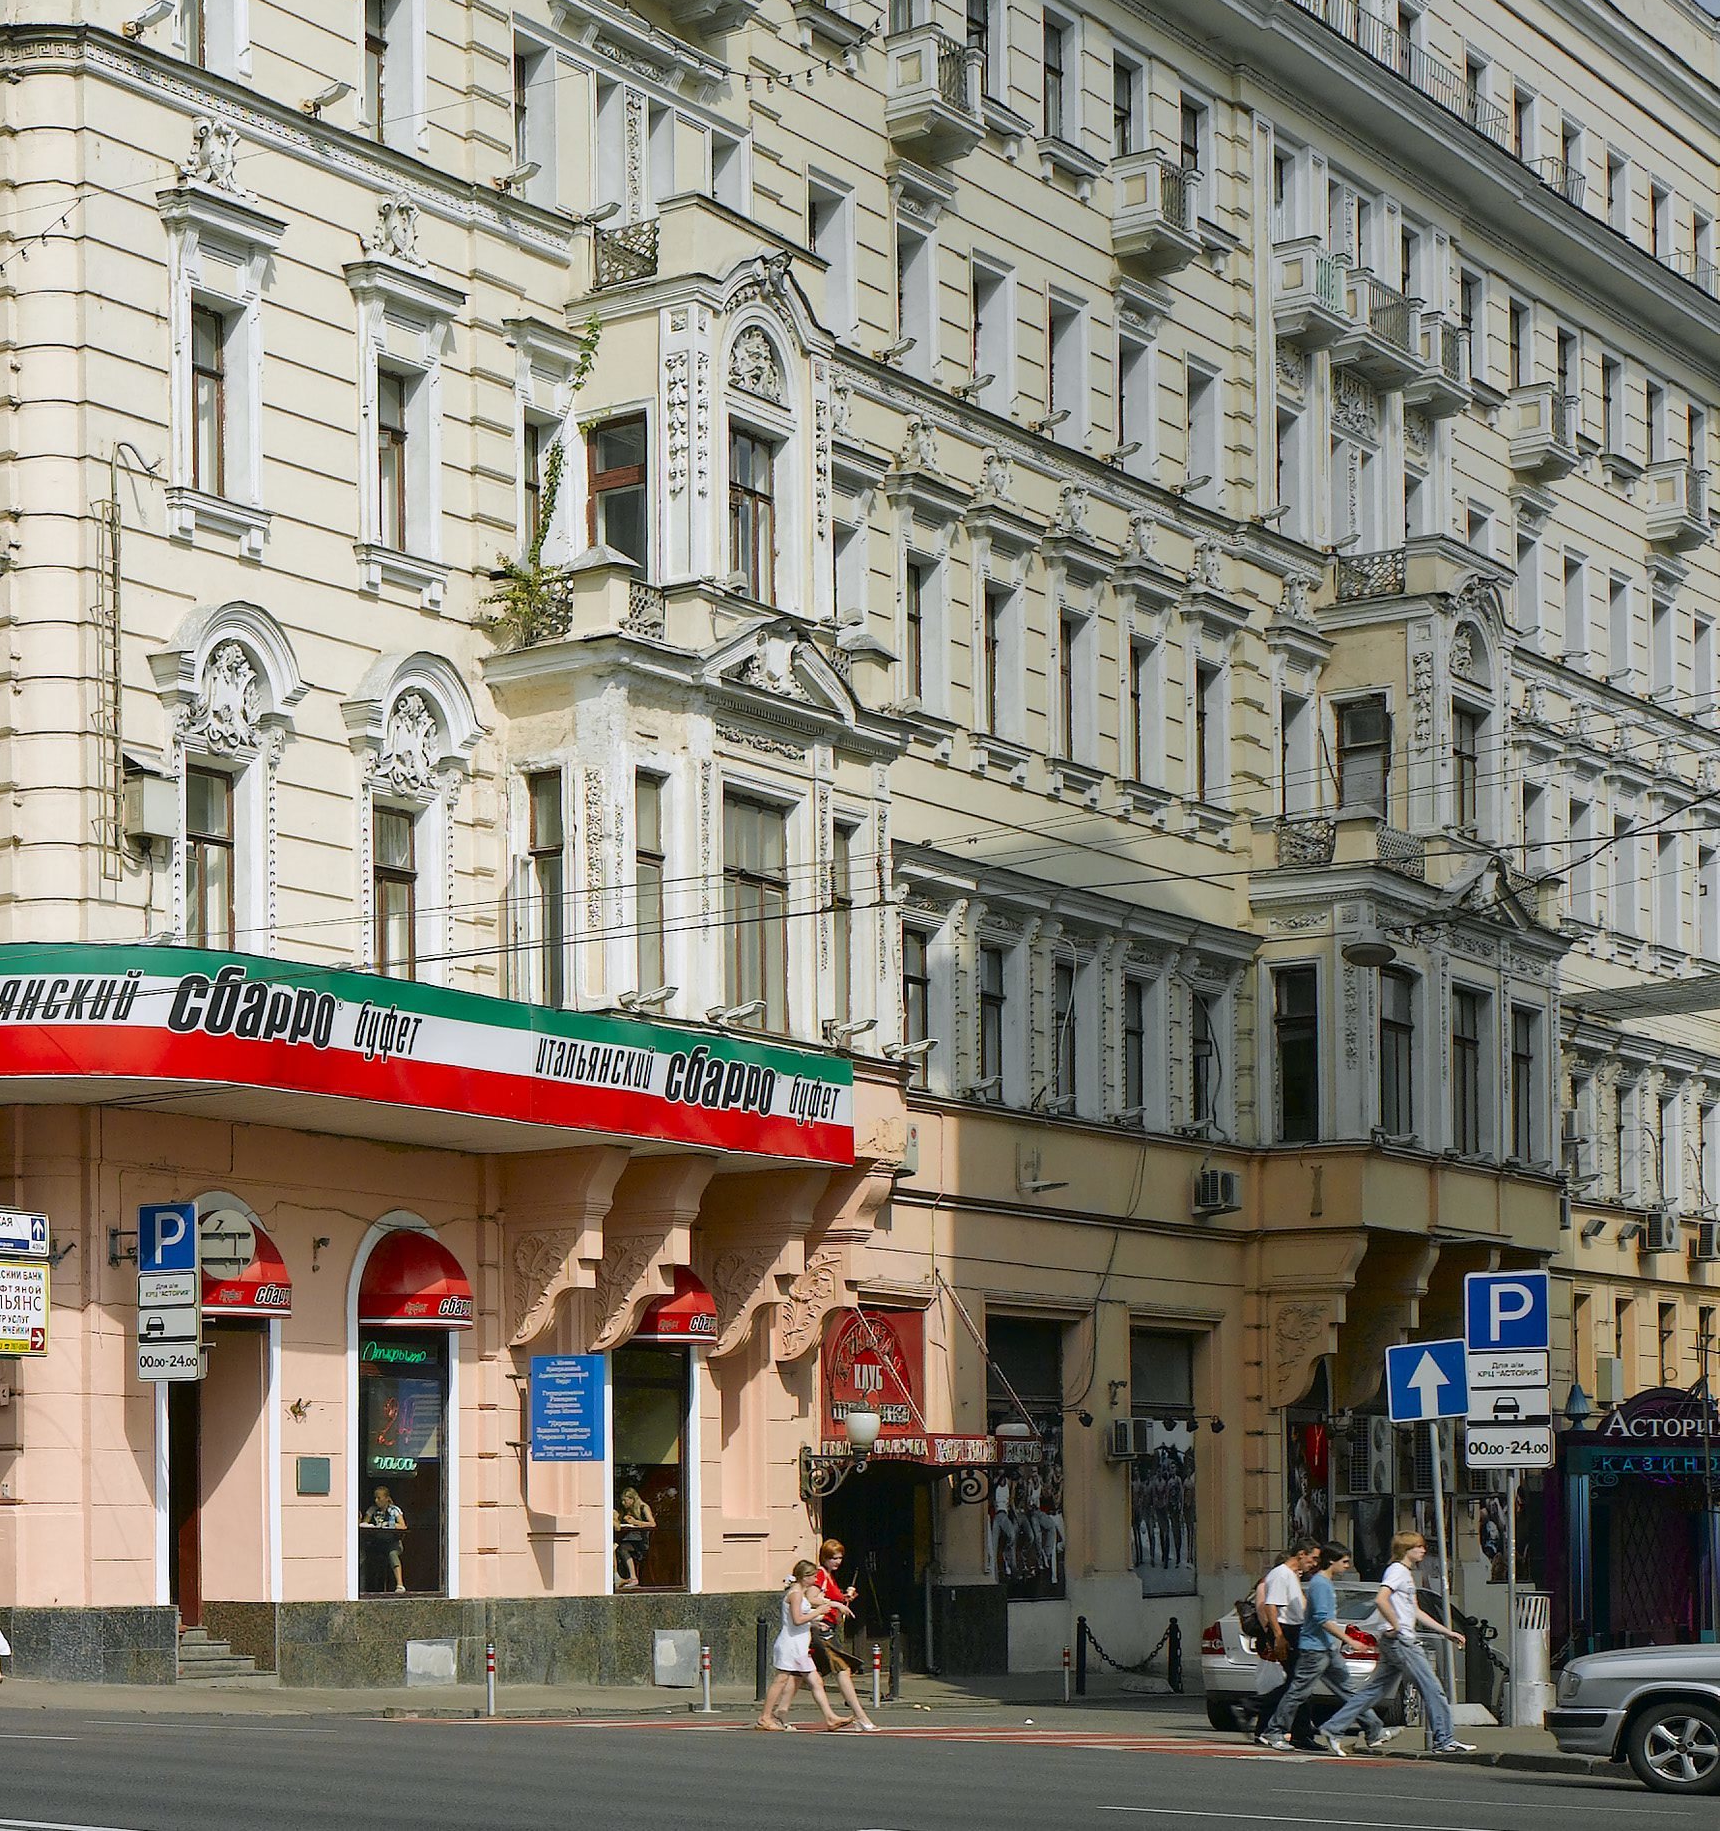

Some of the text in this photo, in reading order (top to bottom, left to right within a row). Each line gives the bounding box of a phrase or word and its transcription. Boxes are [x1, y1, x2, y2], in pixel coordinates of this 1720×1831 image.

[167, 966, 336, 1050] сбарро
[353, 999, 424, 1063] буфет
[535, 1036, 841, 1128] итальянский сбарро буфет
[23, 1270, 43, 1281] БАНК
[7, 1314, 30, 1324] УСЛУГ
[2, 1324, 30, 1335] ЯЧЕЙКИ
[362, 1340, 427, 1363] Открыто
[1491, 1361, 1509, 1370] Для
[854, 1363, 884, 1390] КЛУБ
[1477, 1370, 1495, 1379] КРЦ
[1604, 1409, 1720, 1439] АСТОРИ
